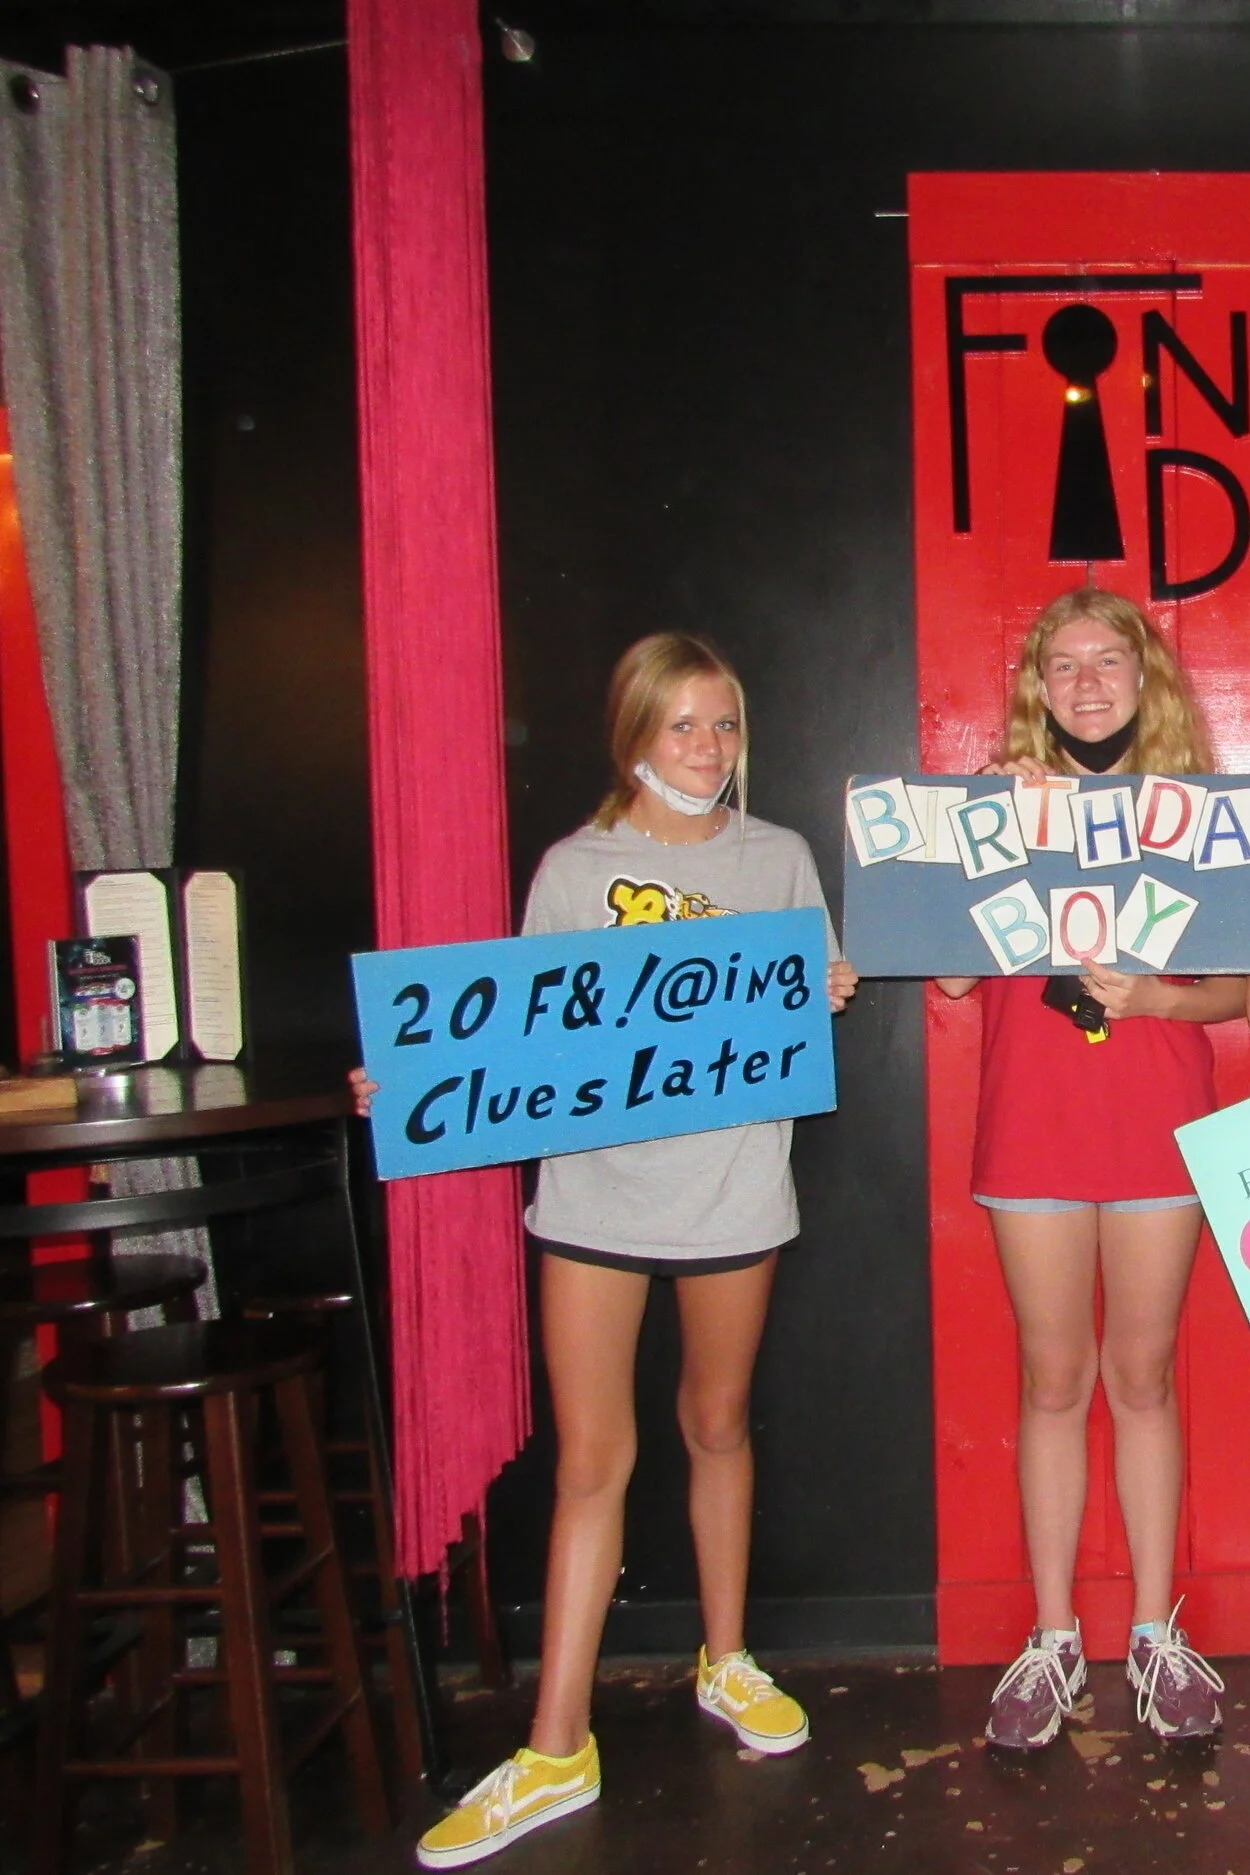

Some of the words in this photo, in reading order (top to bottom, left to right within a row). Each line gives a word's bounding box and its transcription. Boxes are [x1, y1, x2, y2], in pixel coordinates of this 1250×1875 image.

[981, 879, 1190, 967] BOY
[392, 976, 499, 1048] 20
[404, 1066, 608, 1146] Clues
[625, 1037, 808, 1111] Later
